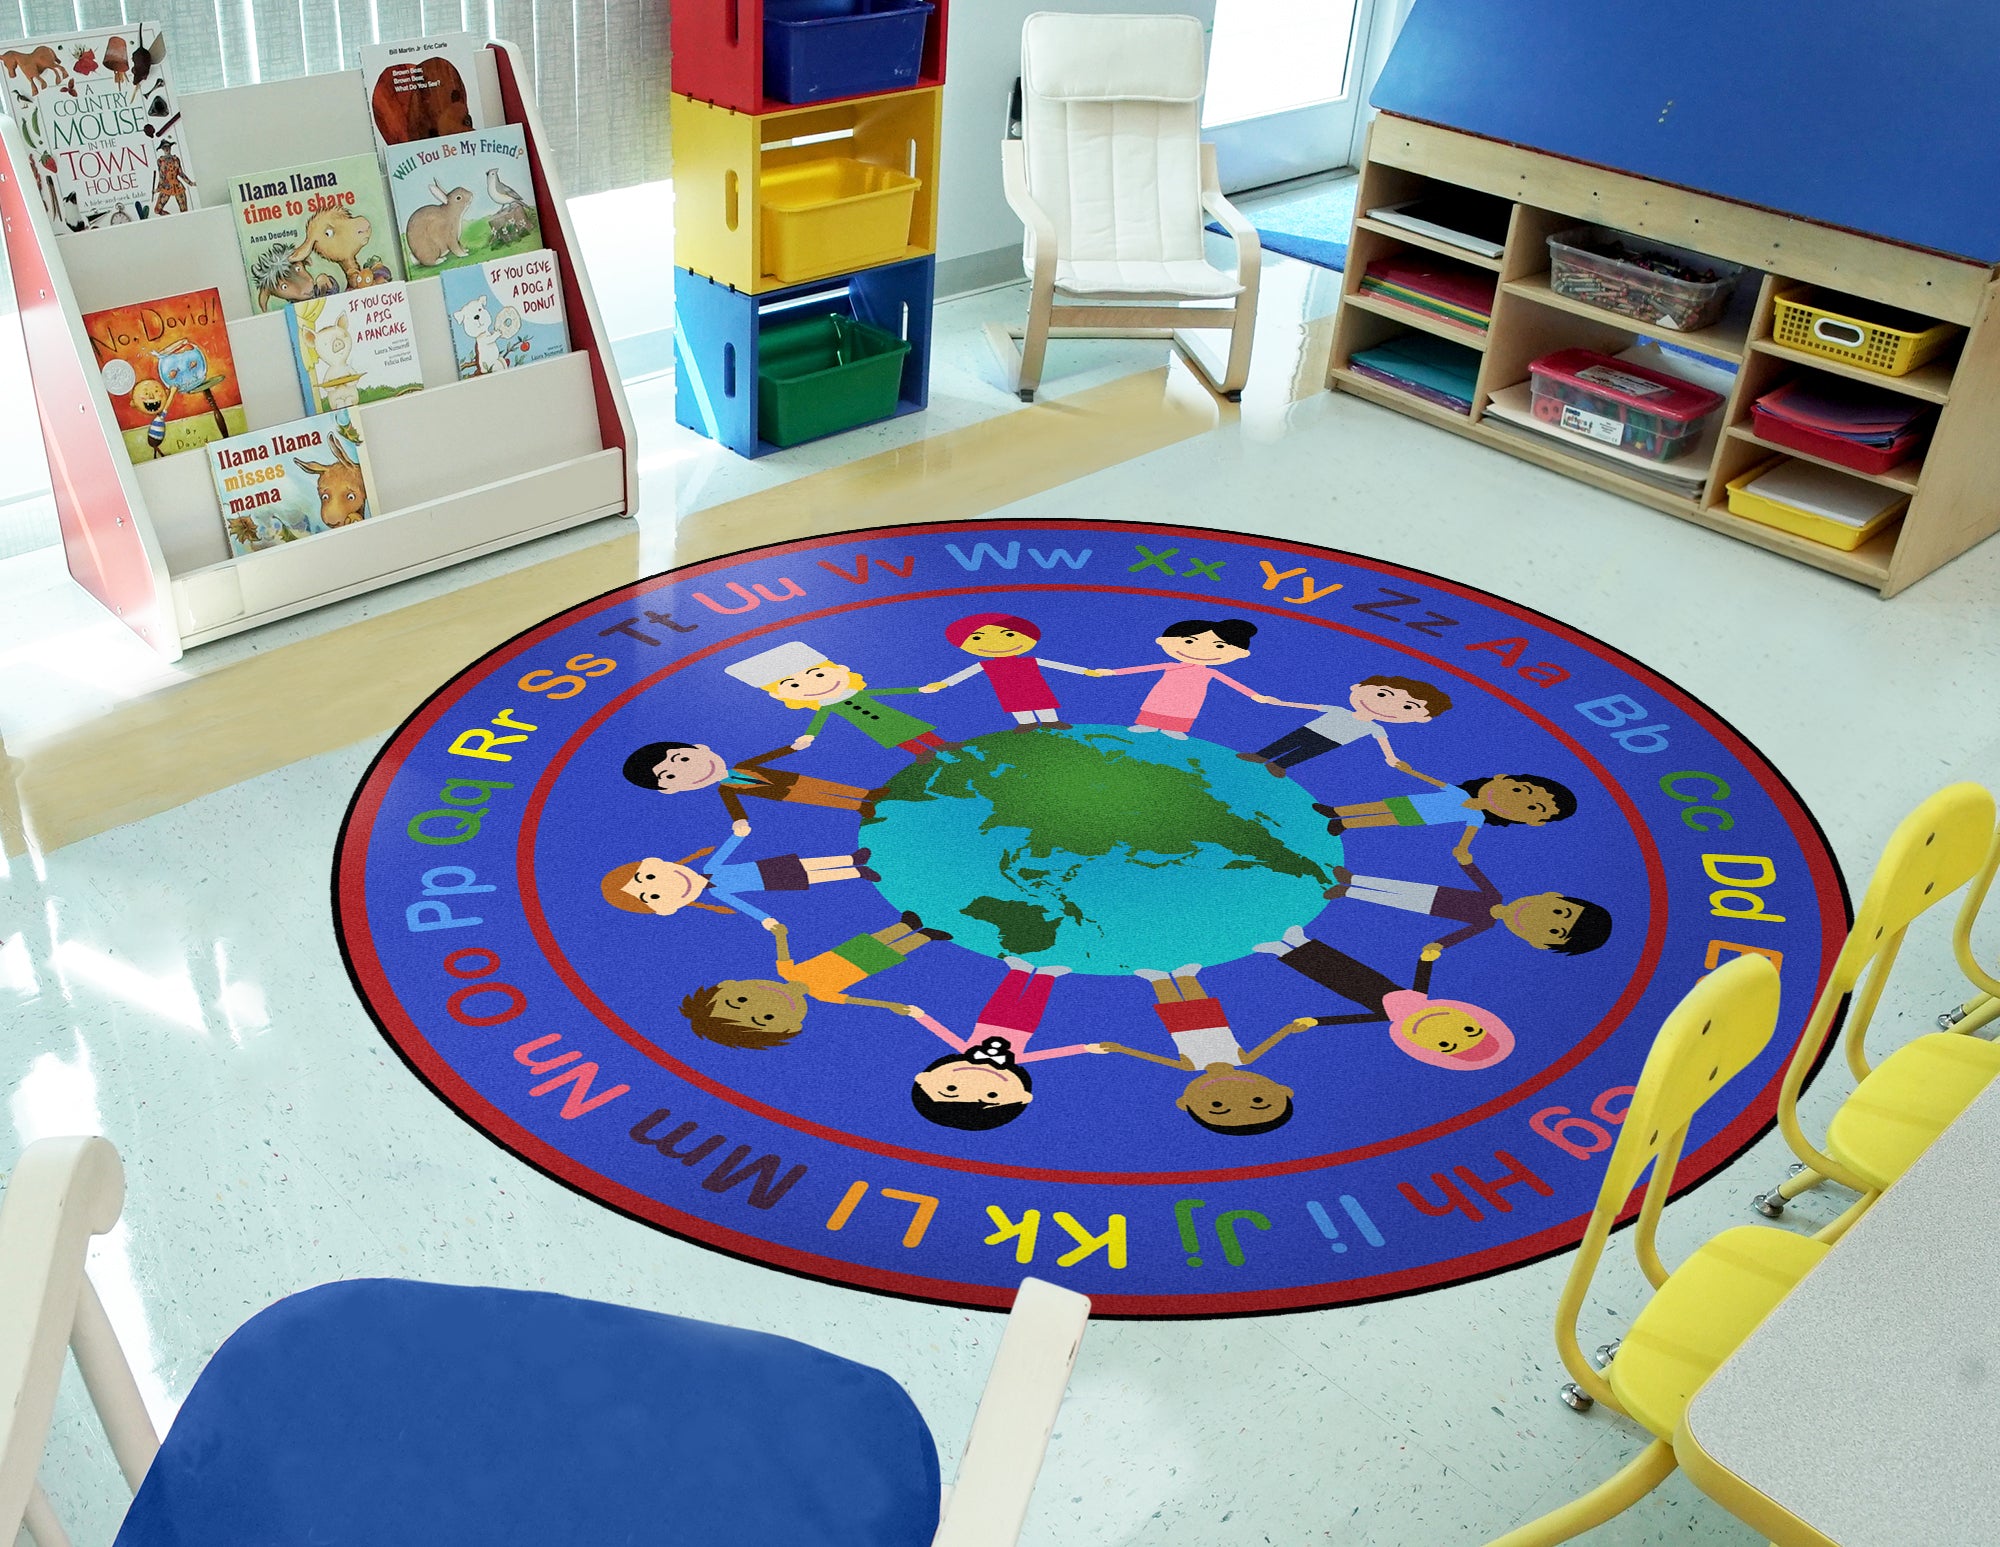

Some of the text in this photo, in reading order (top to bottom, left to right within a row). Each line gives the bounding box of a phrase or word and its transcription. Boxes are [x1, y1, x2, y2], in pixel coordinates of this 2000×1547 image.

[423, 43, 434, 51] Eric
[54, 91, 128, 117] COUNTRY
[85, 84, 94, 95] A
[53, 106, 144, 149] MOUSE
[88, 138, 117, 151] IN THE
[60, 144, 149, 180] TOWN
[393, 139, 525, 182] Will You Be My Friend?
[85, 172, 139, 196] HOUSE
[239, 172, 338, 202] llama llama
[243, 190, 356, 225] time to share
[250, 228, 298, 244] Anna Dewdney
[491, 260, 552, 284] IF YOU GIVE
[513, 277, 554, 298] A DOG A
[140, 297, 216, 342] David!
[349, 291, 405, 313] IF YOU GIVE
[366, 308, 393, 324] A PIG
[523, 294, 556, 314] DONUT
[357, 323, 408, 343] A PANCAKE
[217, 431, 323, 470] llama llama
[224, 464, 286, 493] misses
[229, 488, 282, 514] mama
[817, 555, 916, 584] Vv
[945, 541, 1093, 571] Ww
[1128, 545, 1227, 581] Xx
[692, 577, 807, 614] Uu
[1258, 560, 1343, 604] Yy
[598, 610, 699, 648] Tt
[1352, 587, 1460, 638] Zz
[517, 653, 618, 700] Ss
[1465, 636, 1572, 688] Aa
[447, 709, 539, 763] Rr
[1573, 693, 1671, 754] Bb
[406, 778, 515, 846] Qq
[1658, 770, 1735, 832] Cc
[405, 865, 498, 933] Pp
[1701, 853, 1786, 923] Dd
[443, 947, 528, 1028] Oo
[512, 1033, 631, 1120] Nn
[628, 1108, 809, 1211] Mm
[1396, 1150, 1554, 1223] Hh
[825, 1180, 939, 1248] Ll
[1174, 1199, 1272, 1267] Jj
[1306, 1194, 1386, 1254] Ii
[983, 1205, 1128, 1270] Kk
